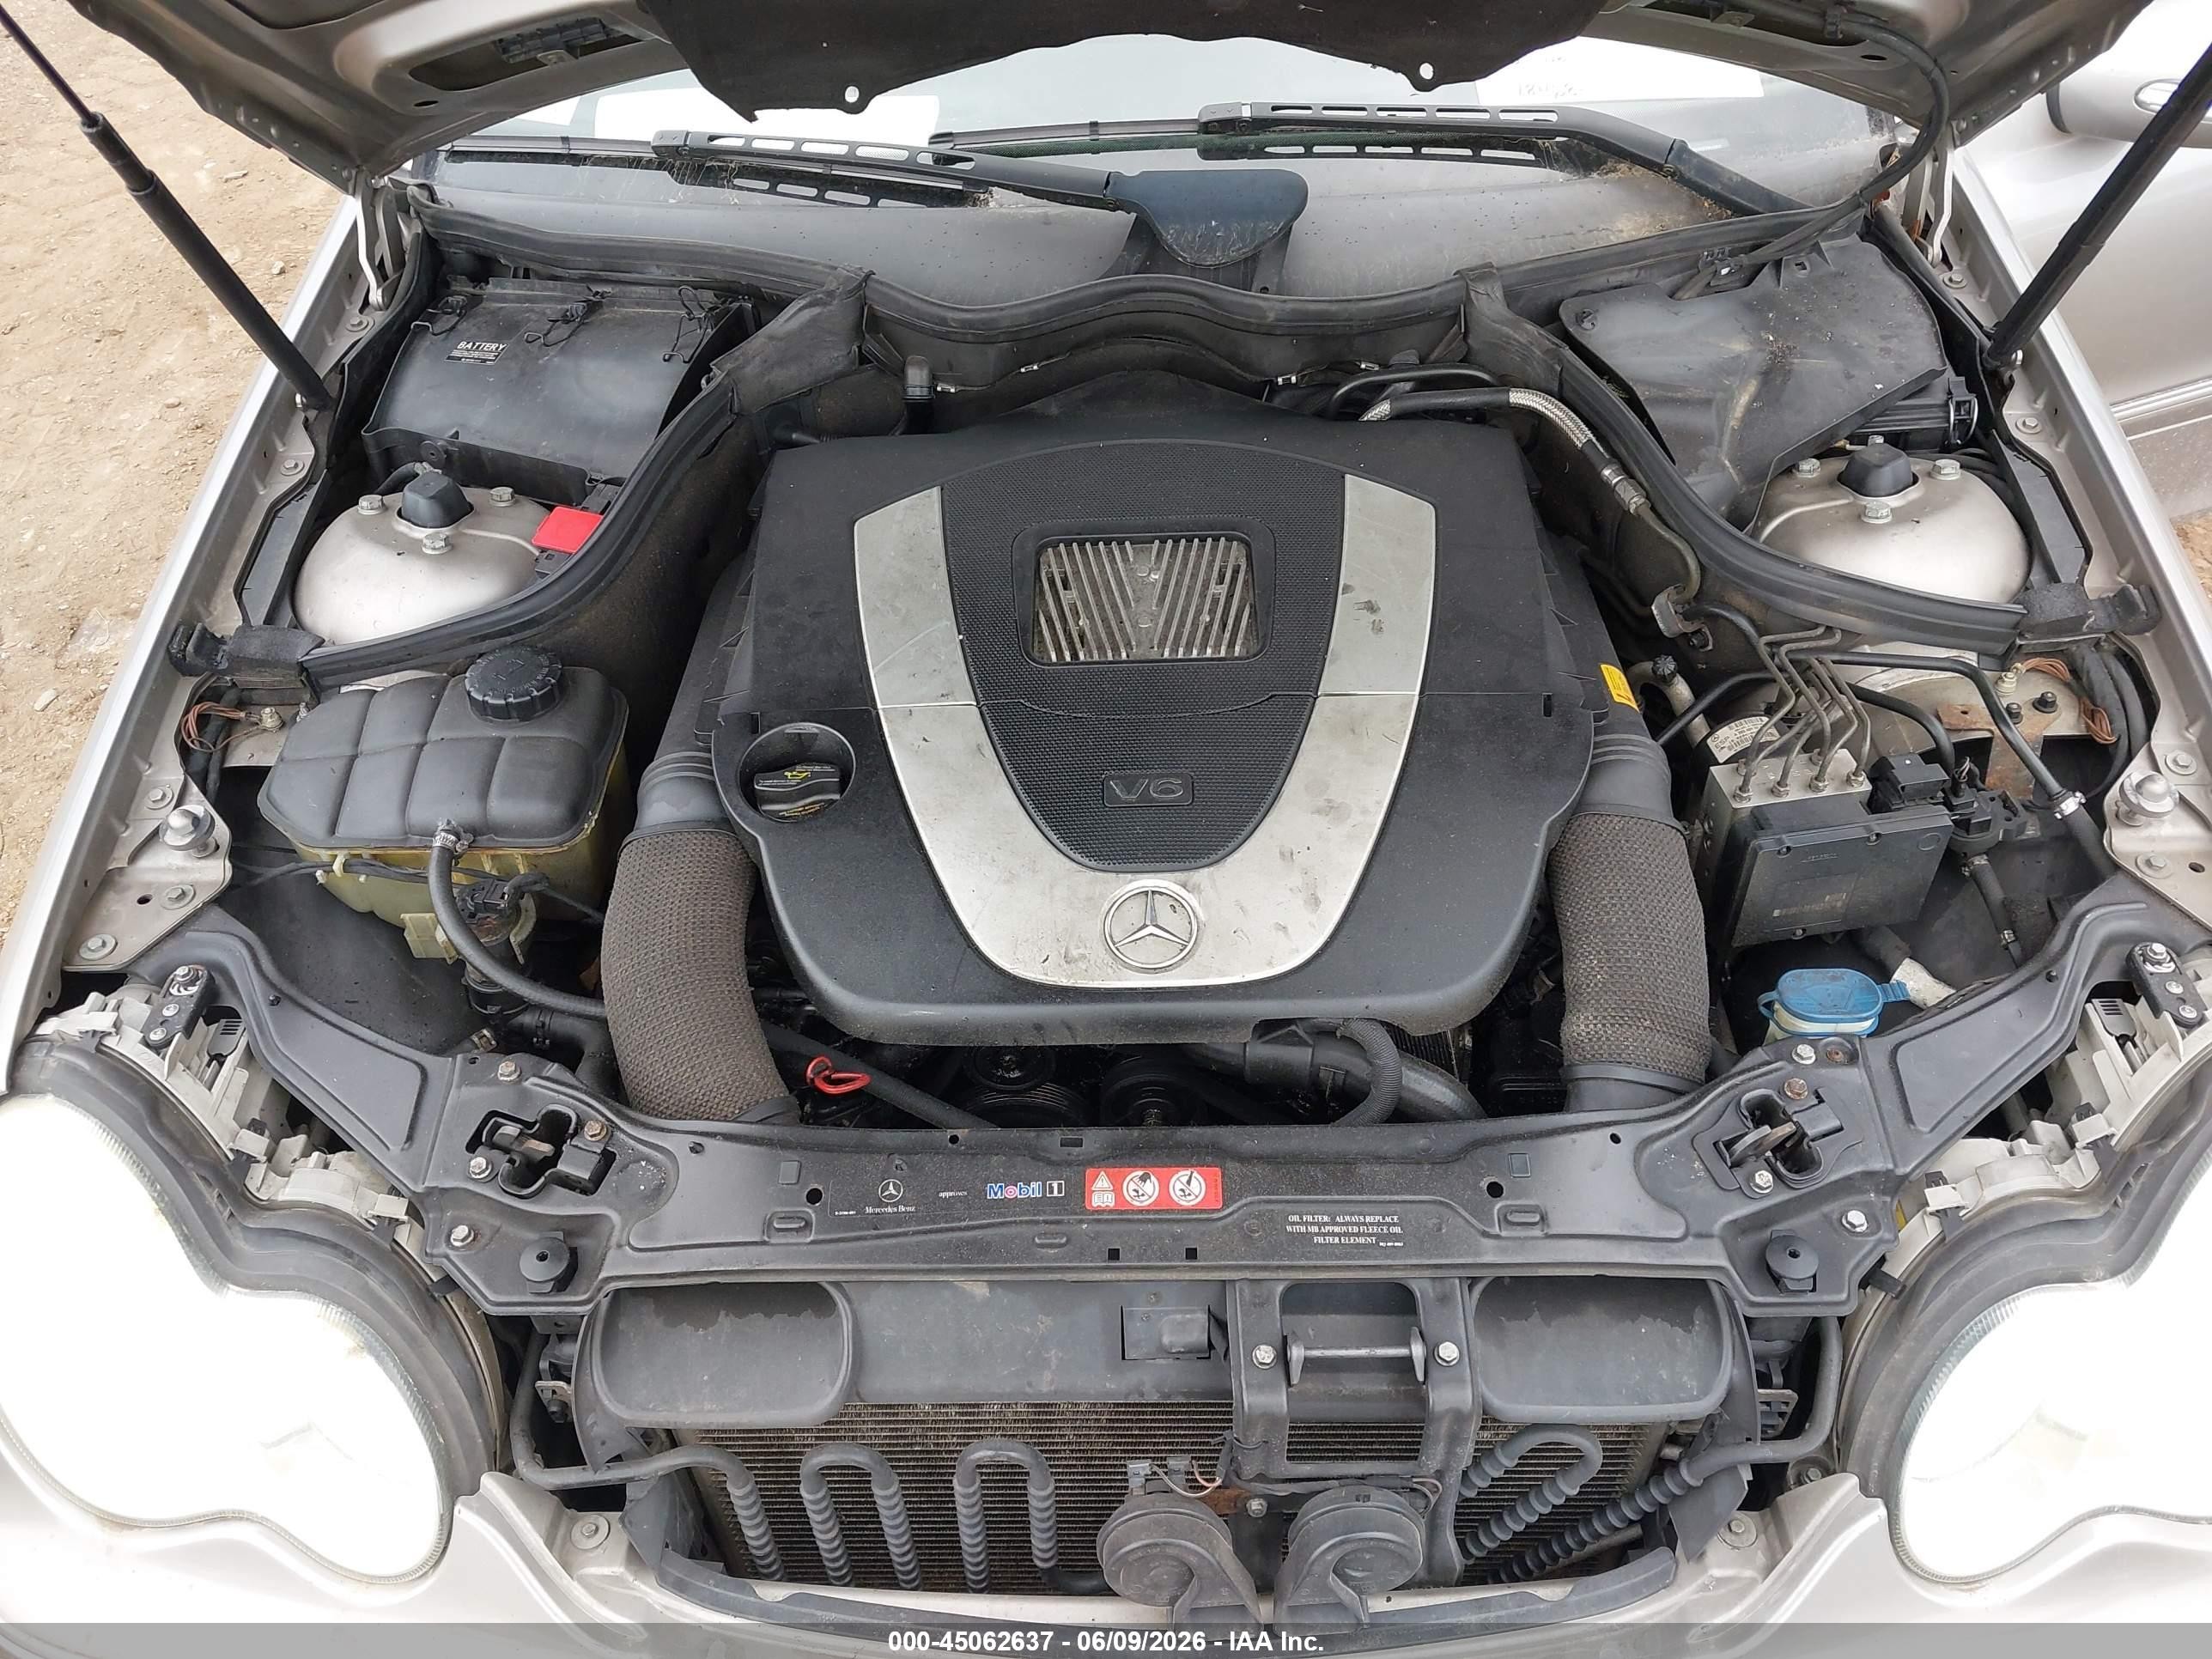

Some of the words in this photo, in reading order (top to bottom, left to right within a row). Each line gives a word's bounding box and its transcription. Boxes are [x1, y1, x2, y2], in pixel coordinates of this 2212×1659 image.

[457, 341, 507, 351] BATTERY
[1109, 778, 1183, 799] V6
[939, 1189, 968, 1198] approves
[987, 1182, 1042, 1199] Mobil
